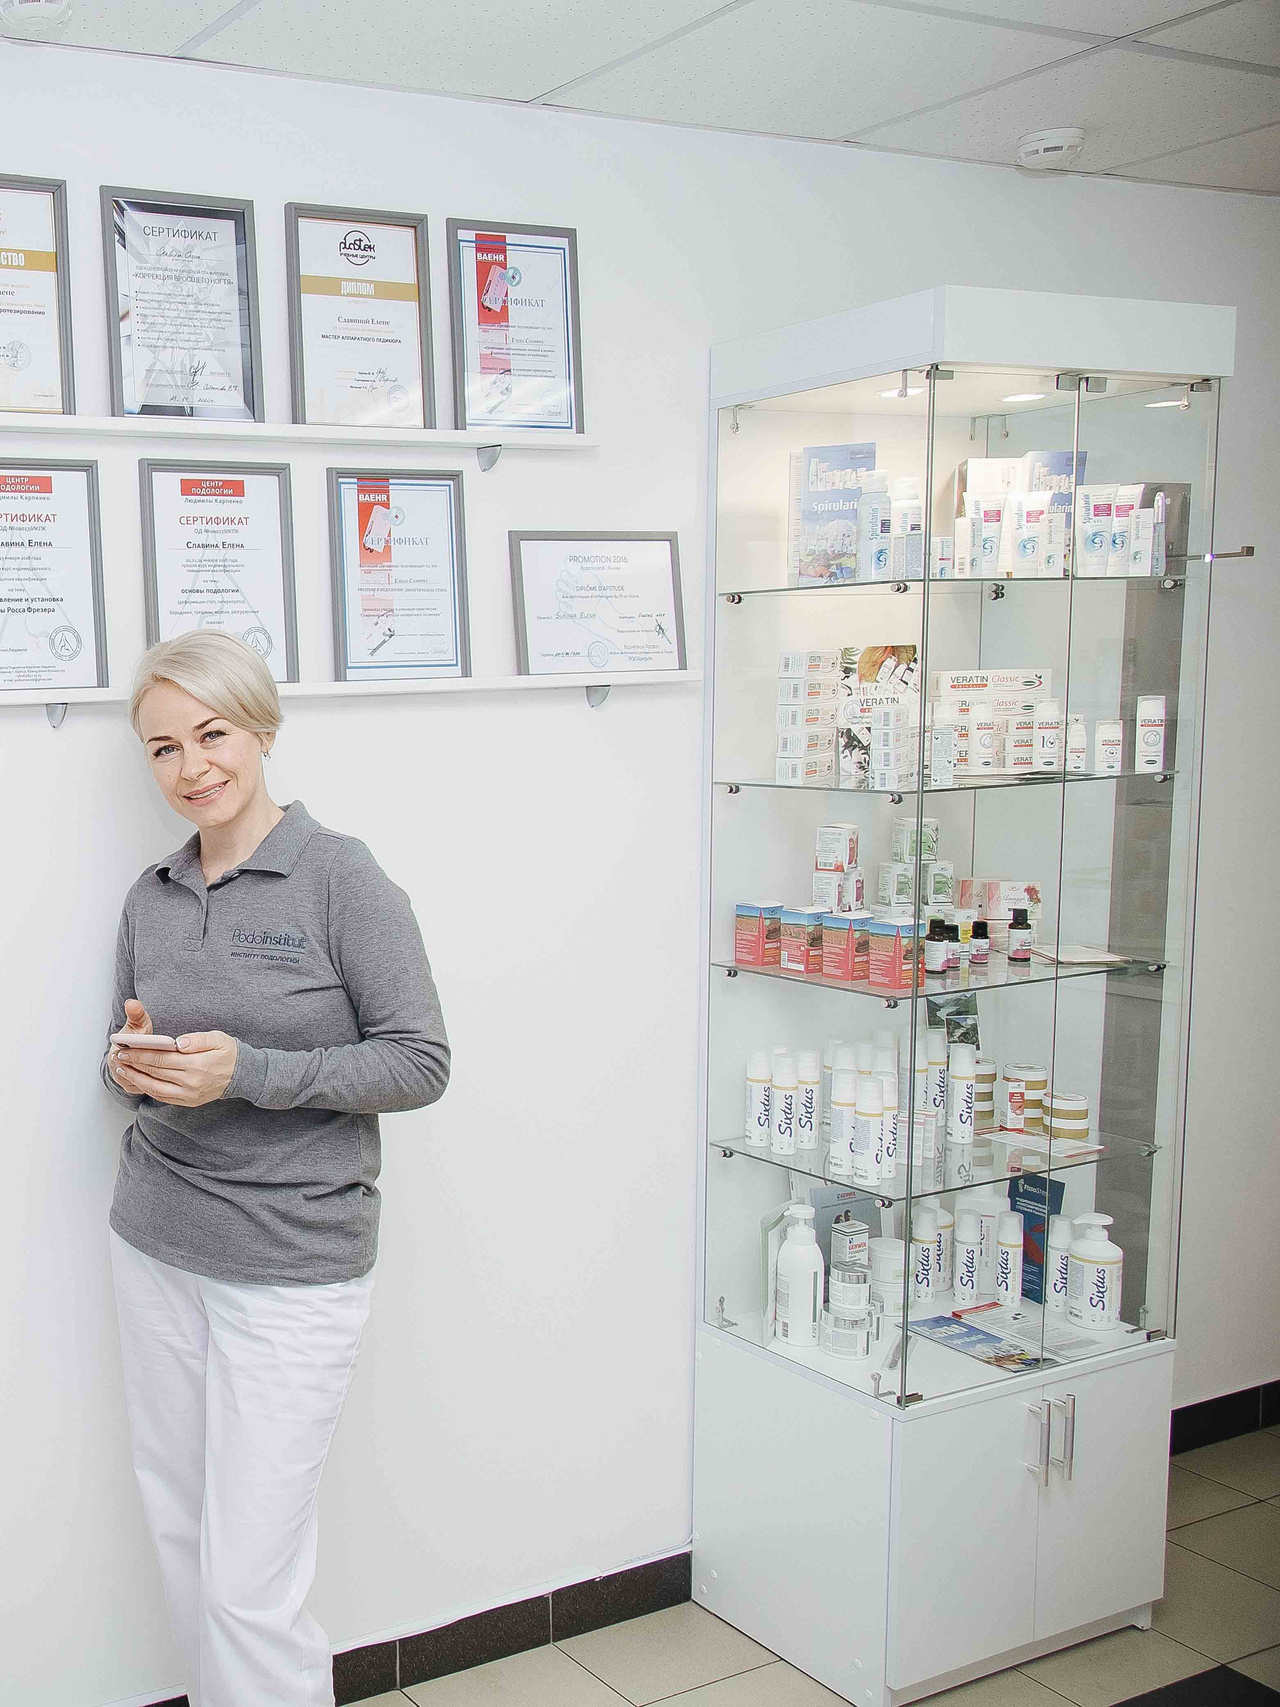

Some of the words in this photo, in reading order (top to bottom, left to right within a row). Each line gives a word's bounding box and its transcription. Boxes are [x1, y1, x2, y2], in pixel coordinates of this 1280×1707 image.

[143, 225, 218, 242] СЕРТИФИКАТ
[477, 253, 505, 262] BAEHR
[341, 281, 374, 296] ДИПЛОМ
[338, 316, 370, 325] Славиной
[371, 318, 390, 326] Елене
[341, 335, 375, 343] АППАРАТНОГО
[191, 487, 233, 495] ПОДОЛОГИИ
[358, 494, 387, 502] BAEHR
[812, 500, 857, 513] Spirulari
[179, 516, 250, 526] СЕРТИФИКАТ
[364, 537, 430, 546] СЕРТИФИКАТ
[992, 675, 1019, 683] Classic
[860, 697, 899, 707] VERATIN
[232, 929, 307, 949] Podoinstitut
[231, 951, 259, 959] ИНСТИТУТ
[932, 1068, 946, 1109] Sixtus
[758, 1086, 771, 1129] Sixtus
[798, 1088, 816, 1132] Sixtus
[960, 1083, 974, 1127] Sixtus
[778, 1094, 794, 1138] Sixtus
[886, 1114, 898, 1158] Sixtus
[916, 1247, 931, 1288] Sixtus
[960, 1249, 976, 1290] Sixtus
[997, 1249, 1011, 1291] Sixtus
[1053, 1254, 1069, 1296] Sixtus
[1090, 1268, 1108, 1311] Sixtus
